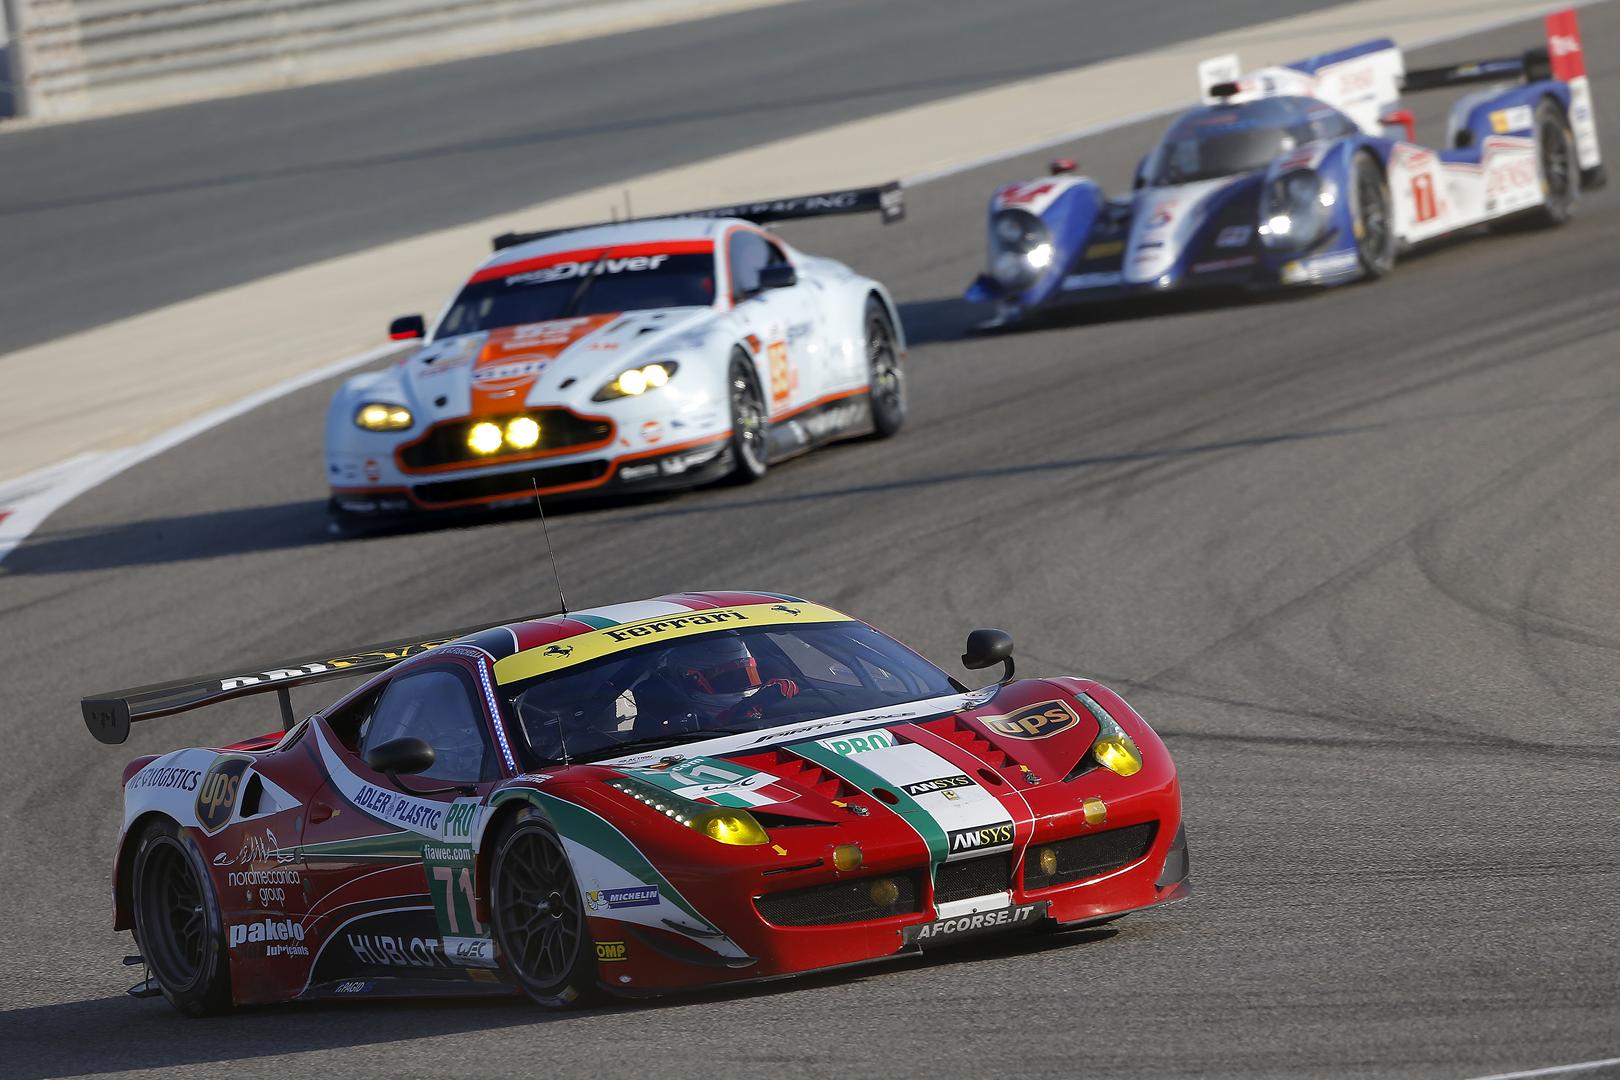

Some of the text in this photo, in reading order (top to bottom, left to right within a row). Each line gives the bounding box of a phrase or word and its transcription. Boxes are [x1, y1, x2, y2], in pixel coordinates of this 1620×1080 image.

[602, 609, 750, 643] Ferrari
[991, 708, 1071, 735] ups
[832, 734, 891, 758] PRO
[201, 772, 240, 819] ups
[910, 776, 970, 795] ANSYS
[354, 785, 442, 831] ADLER PLASTIC
[444, 802, 477, 837] PRO
[952, 824, 1013, 851] ANSYS
[423, 844, 471, 860] fiawec.com
[228, 864, 301, 887] nordmeccanica
[259, 887, 286, 908] group
[432, 866, 483, 935] 71
[609, 890, 658, 902] MICHELIN
[229, 918, 305, 948] pakelo
[917, 906, 1034, 940] AFCORSE.IT
[266, 944, 309, 957] lubricants
[347, 934, 447, 967] HUBLOT
[456, 942, 488, 958] WEC
[596, 944, 627, 958] OMP
